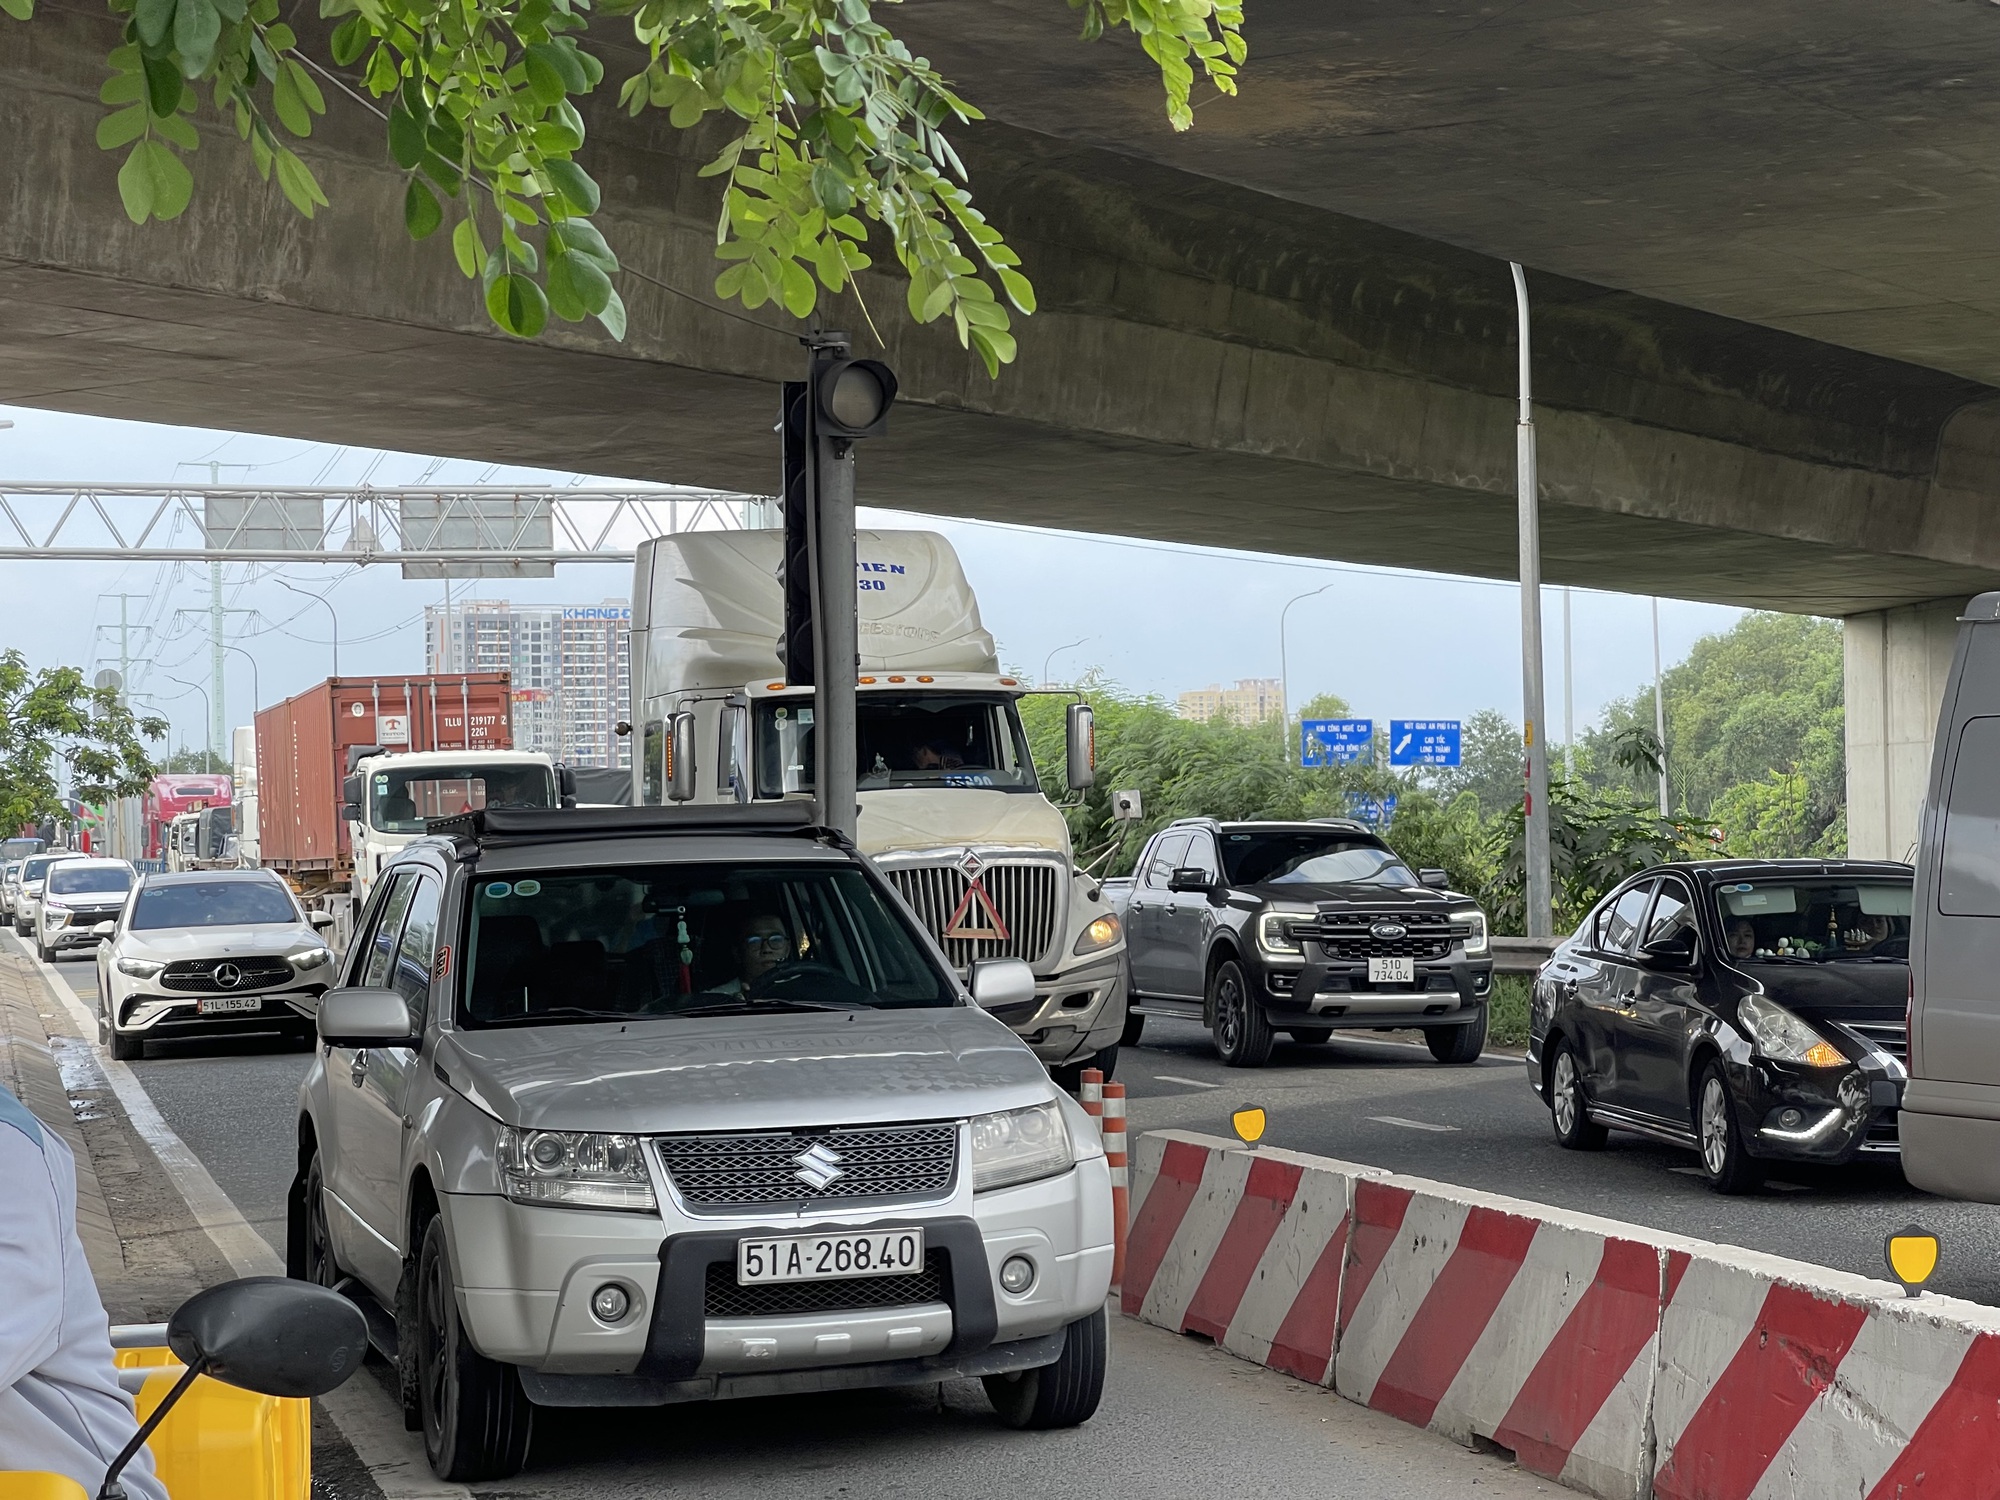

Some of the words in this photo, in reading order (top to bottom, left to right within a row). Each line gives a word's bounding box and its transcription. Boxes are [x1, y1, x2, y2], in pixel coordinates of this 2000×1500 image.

[857, 562, 905, 575] IEN
[857, 580, 886, 591] 30
[563, 608, 619, 619] KHANG
[444, 717, 462, 727] TLLU
[470, 715, 496, 726] 219177
[501, 715, 507, 725] 2
[471, 727, 488, 737] 22G1
[1381, 959, 1401, 970] 51D
[1374, 970, 1409, 981] 734.04
[203, 999, 256, 1011] 51L-155.42
[746, 1235, 915, 1277] 51A-268.40
